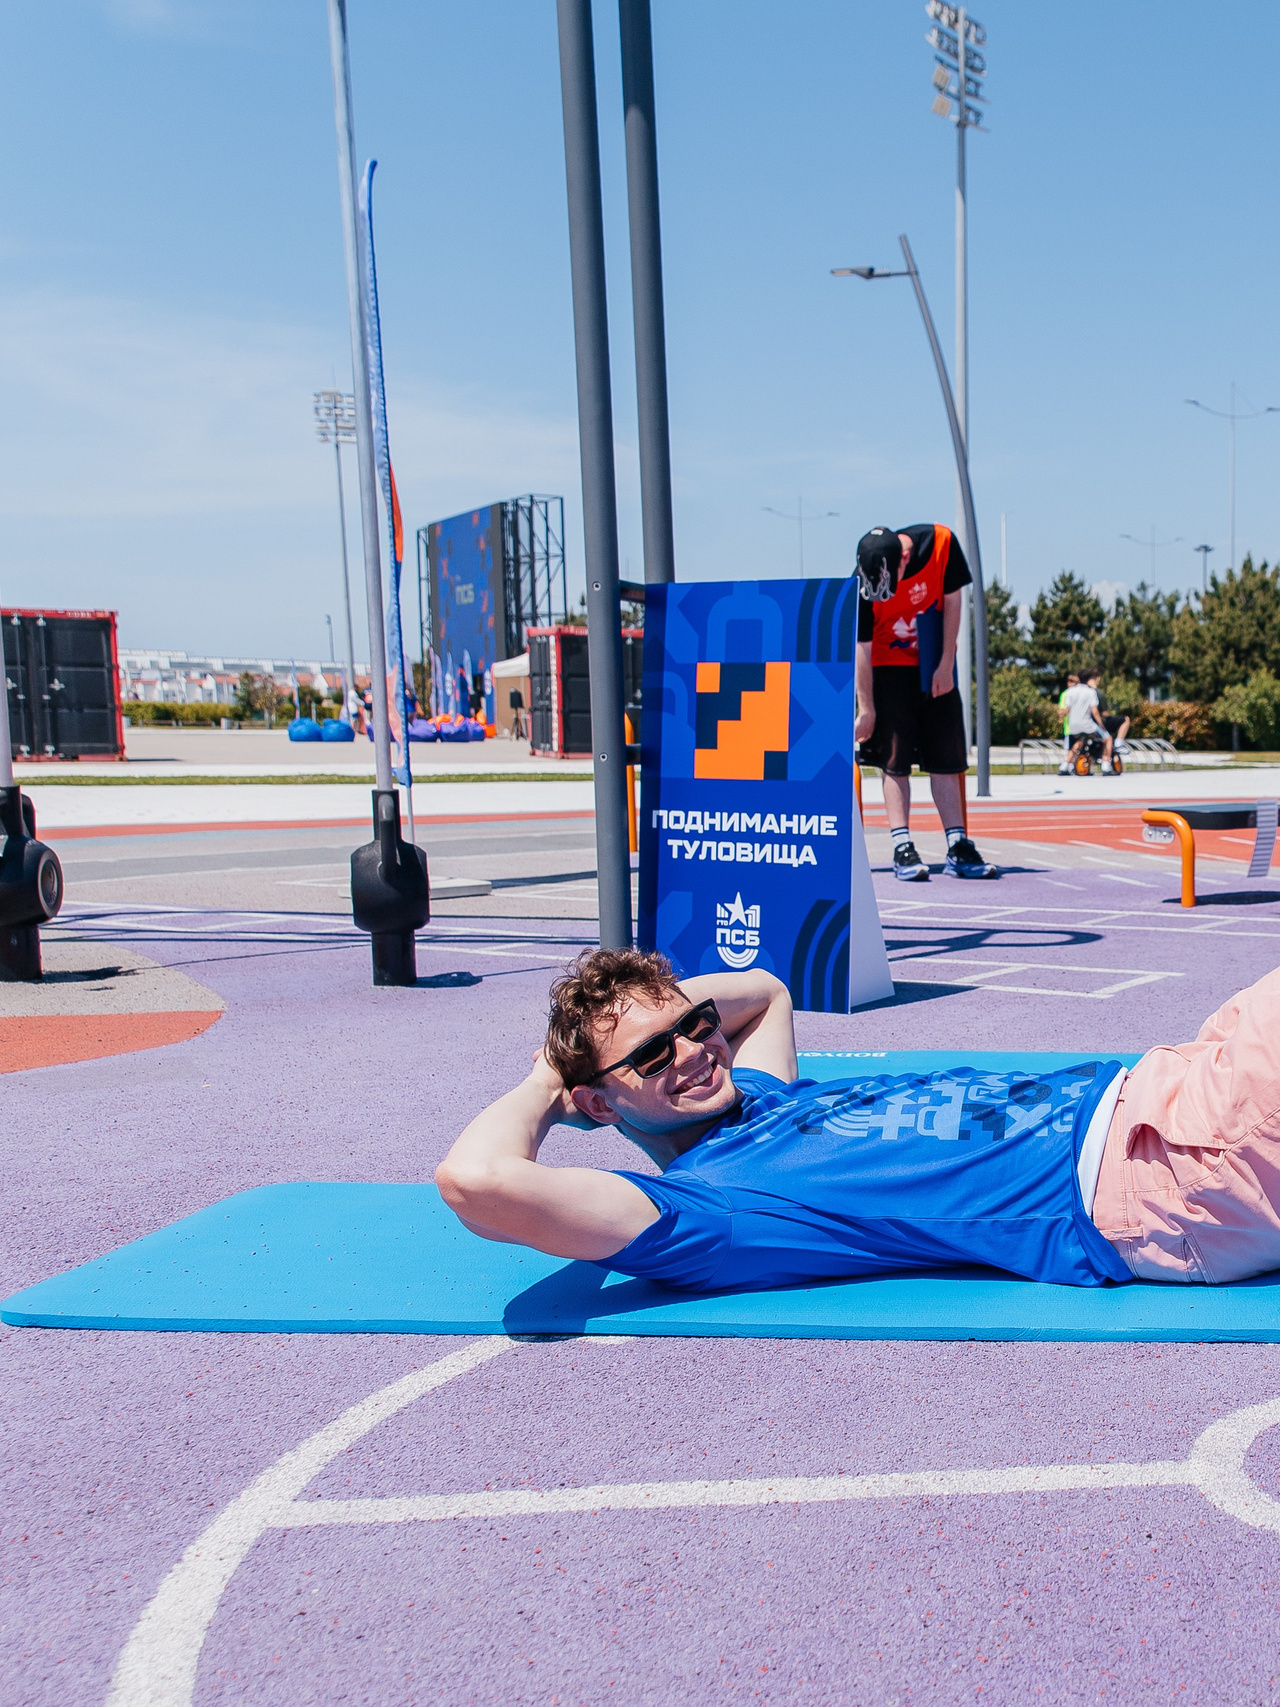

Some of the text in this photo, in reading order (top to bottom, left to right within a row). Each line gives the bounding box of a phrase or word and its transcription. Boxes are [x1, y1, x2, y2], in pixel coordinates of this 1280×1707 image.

[652, 809, 838, 836] ПОДНИМАНИЕ
[667, 838, 817, 868] ТУЛОВИЩА
[716, 927, 760, 947] ПСБ
